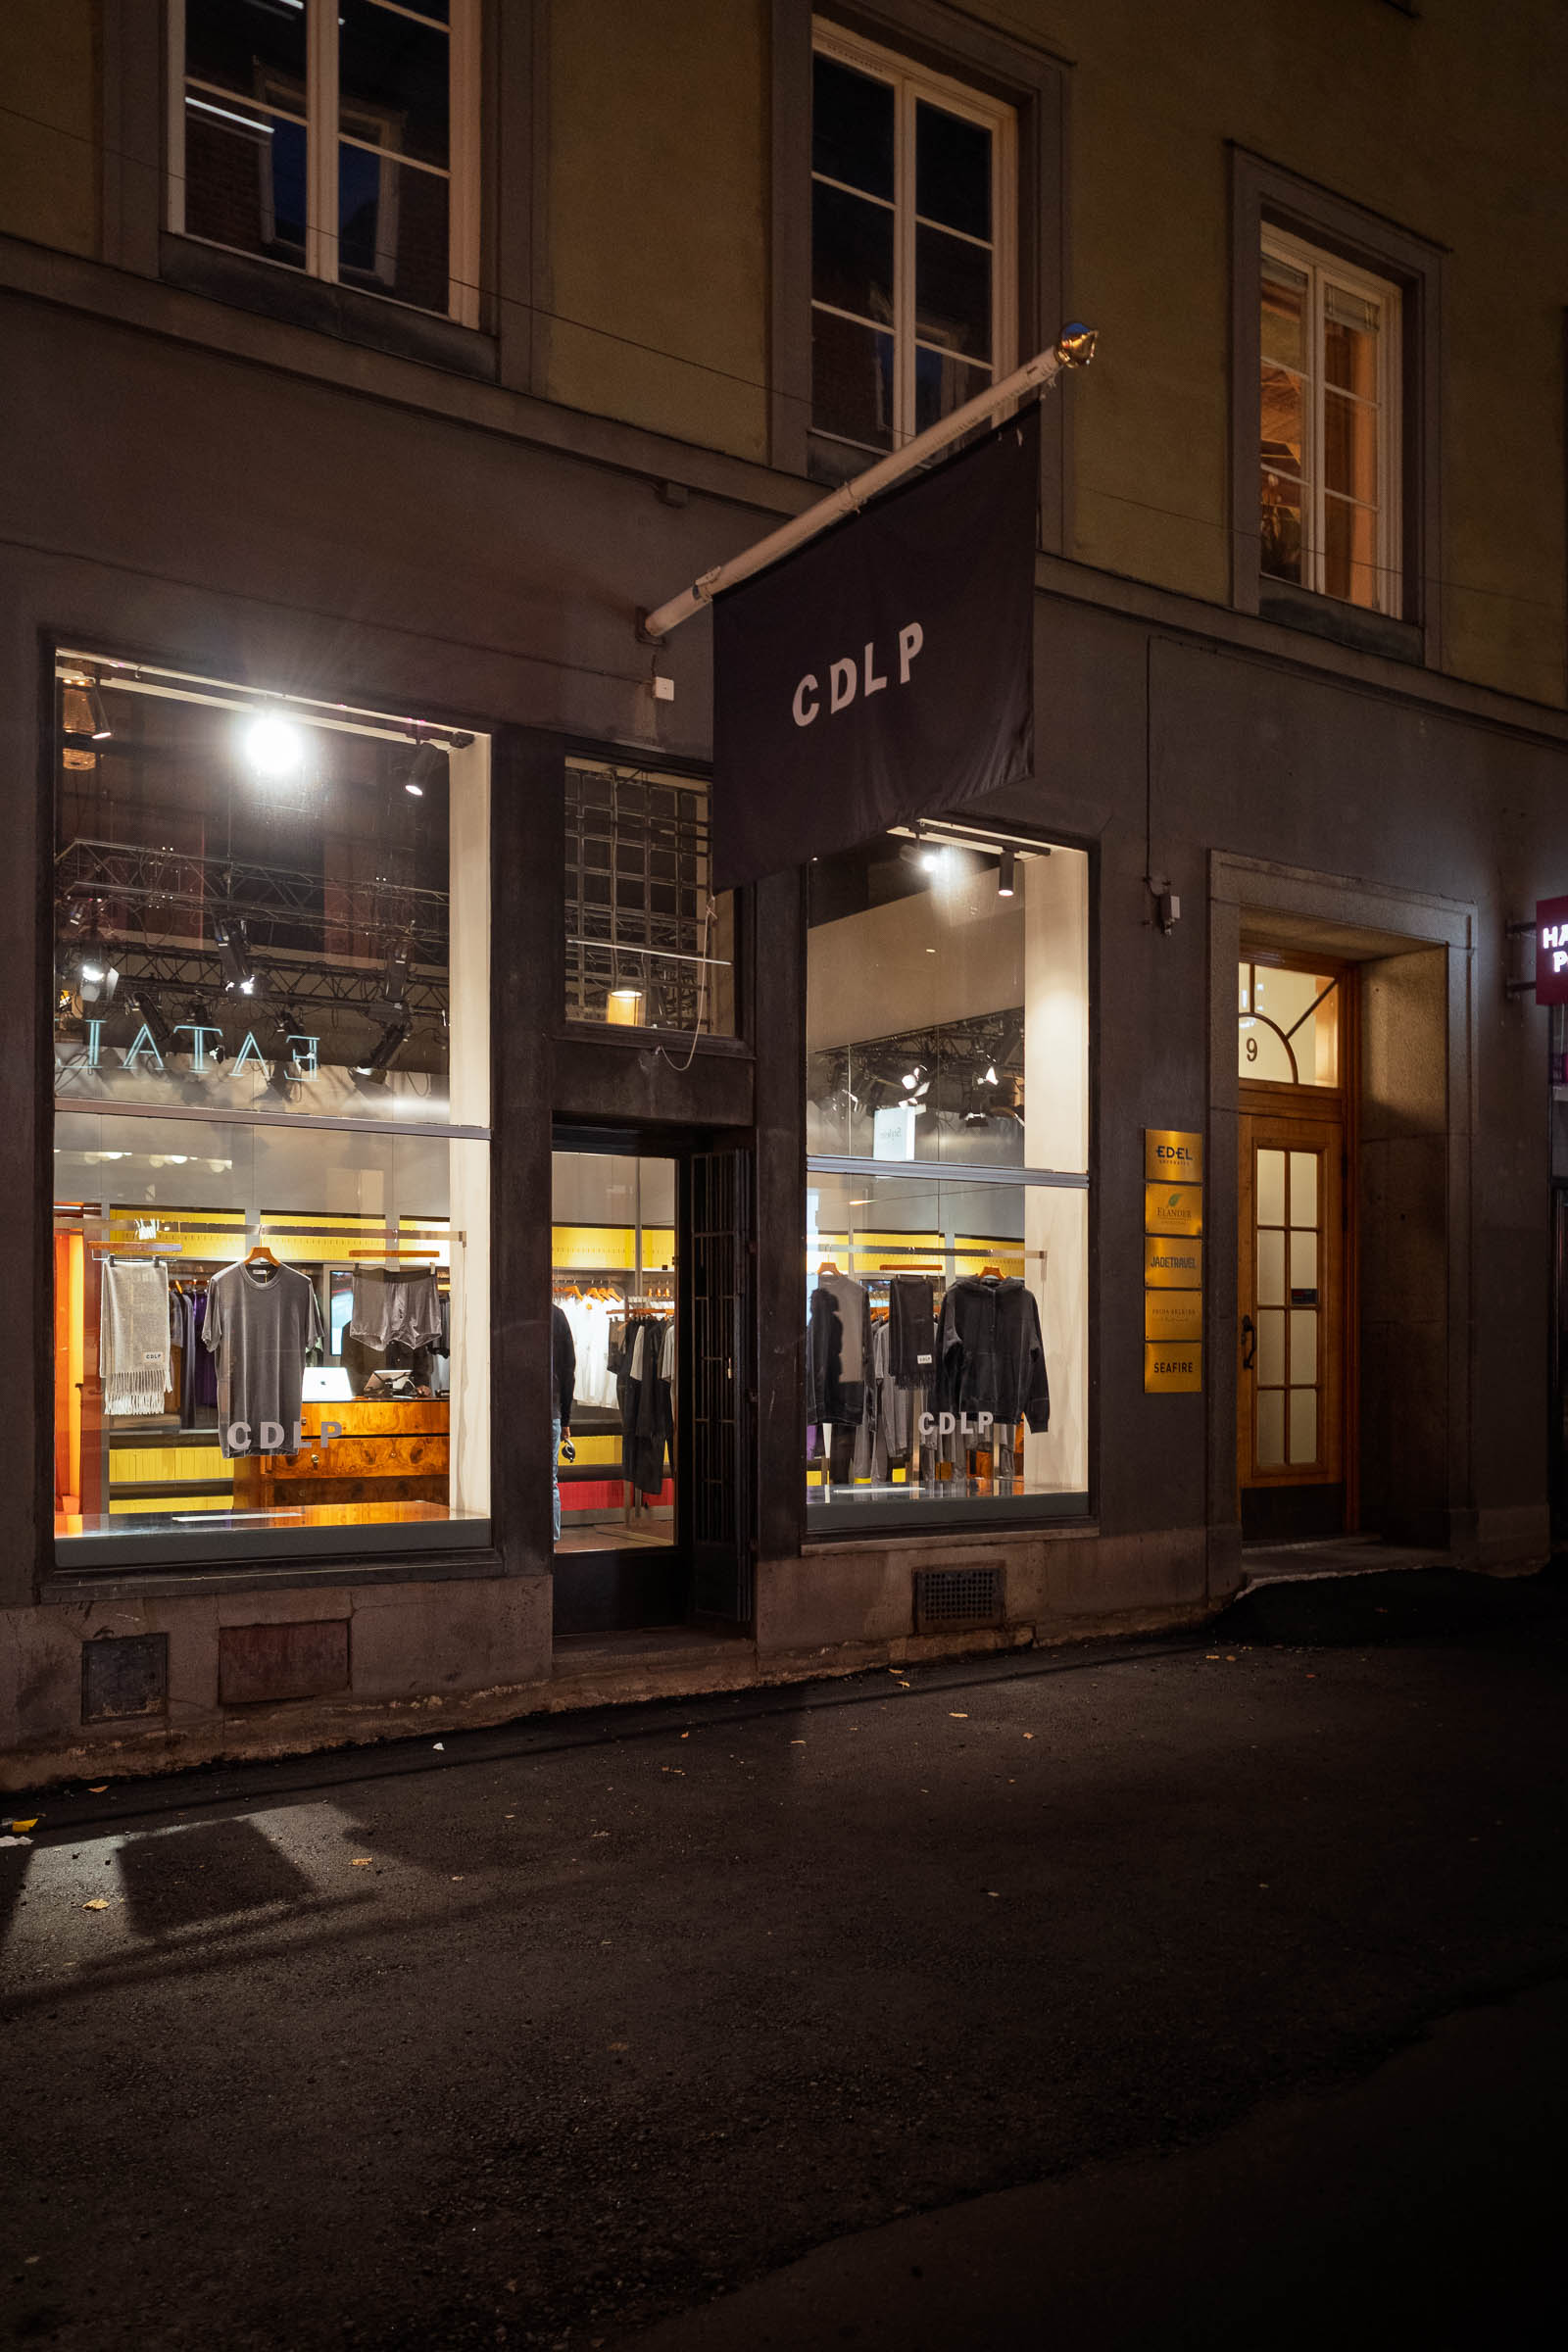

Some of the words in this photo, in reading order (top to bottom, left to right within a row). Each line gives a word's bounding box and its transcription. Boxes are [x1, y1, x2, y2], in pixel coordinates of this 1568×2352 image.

[792, 621, 925, 727] CDLP
[1552, 951, 1568, 973] P
[1246, 1038, 1258, 1061] 9
[1156, 1146, 1193, 1160] EDEL
[1153, 1362, 1193, 1373] SEAFIRE
[226, 1420, 343, 1450] CDLP
[917, 1411, 994, 1436] CDLP
